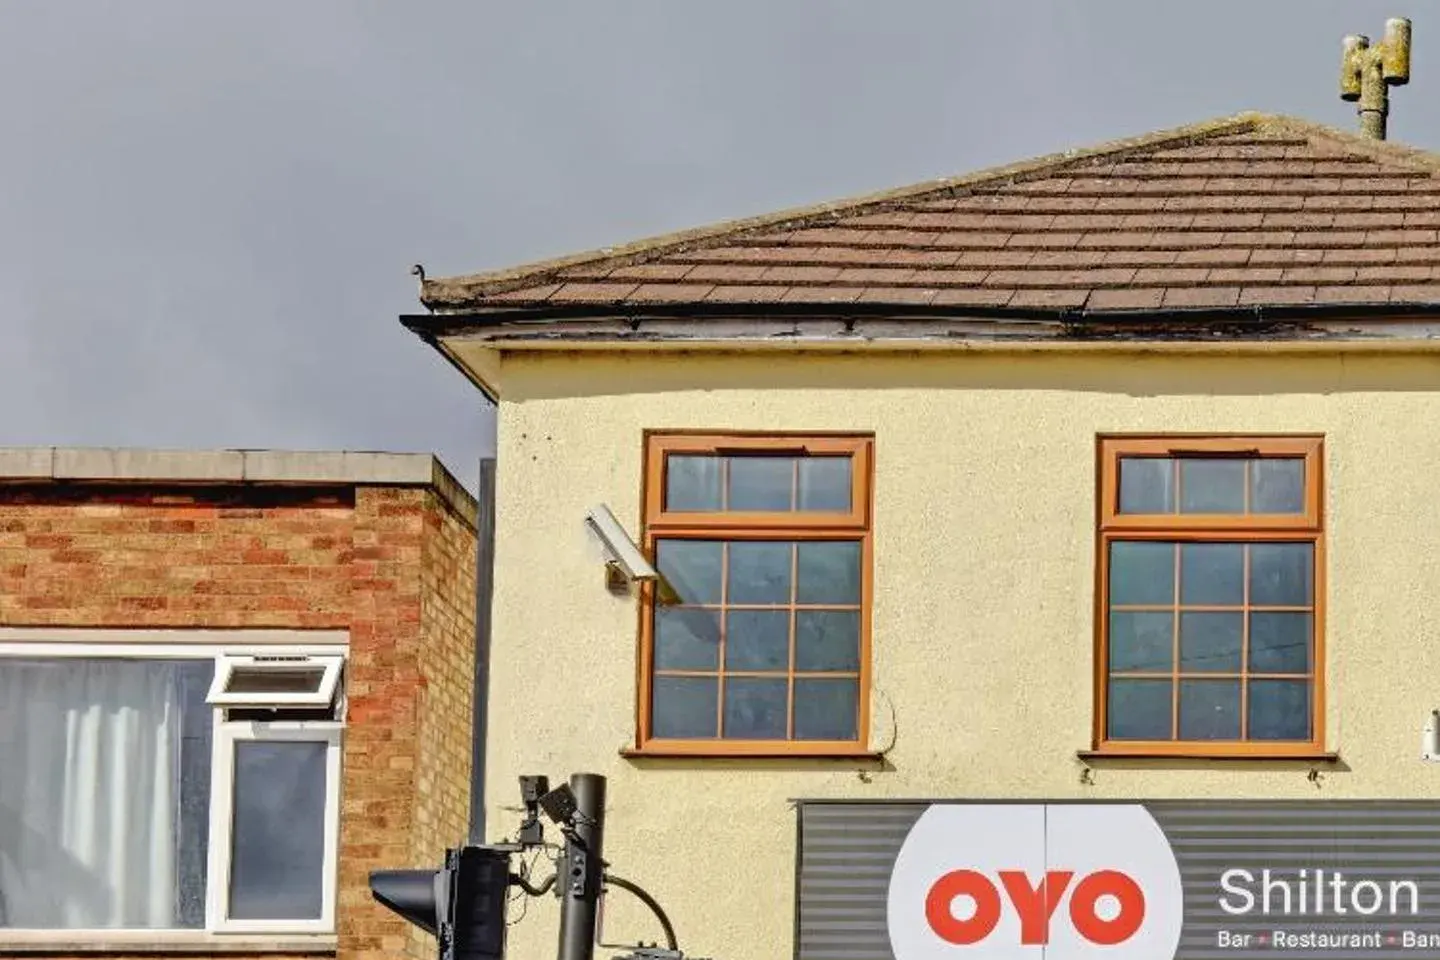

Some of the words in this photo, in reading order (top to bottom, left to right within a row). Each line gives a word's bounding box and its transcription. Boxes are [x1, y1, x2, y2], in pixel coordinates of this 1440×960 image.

[925, 869, 1146, 945] OYO
[1218, 868, 1418, 915] Shilton
[1218, 931, 1250, 948] Bar
[1273, 931, 1382, 948] Restaurant
